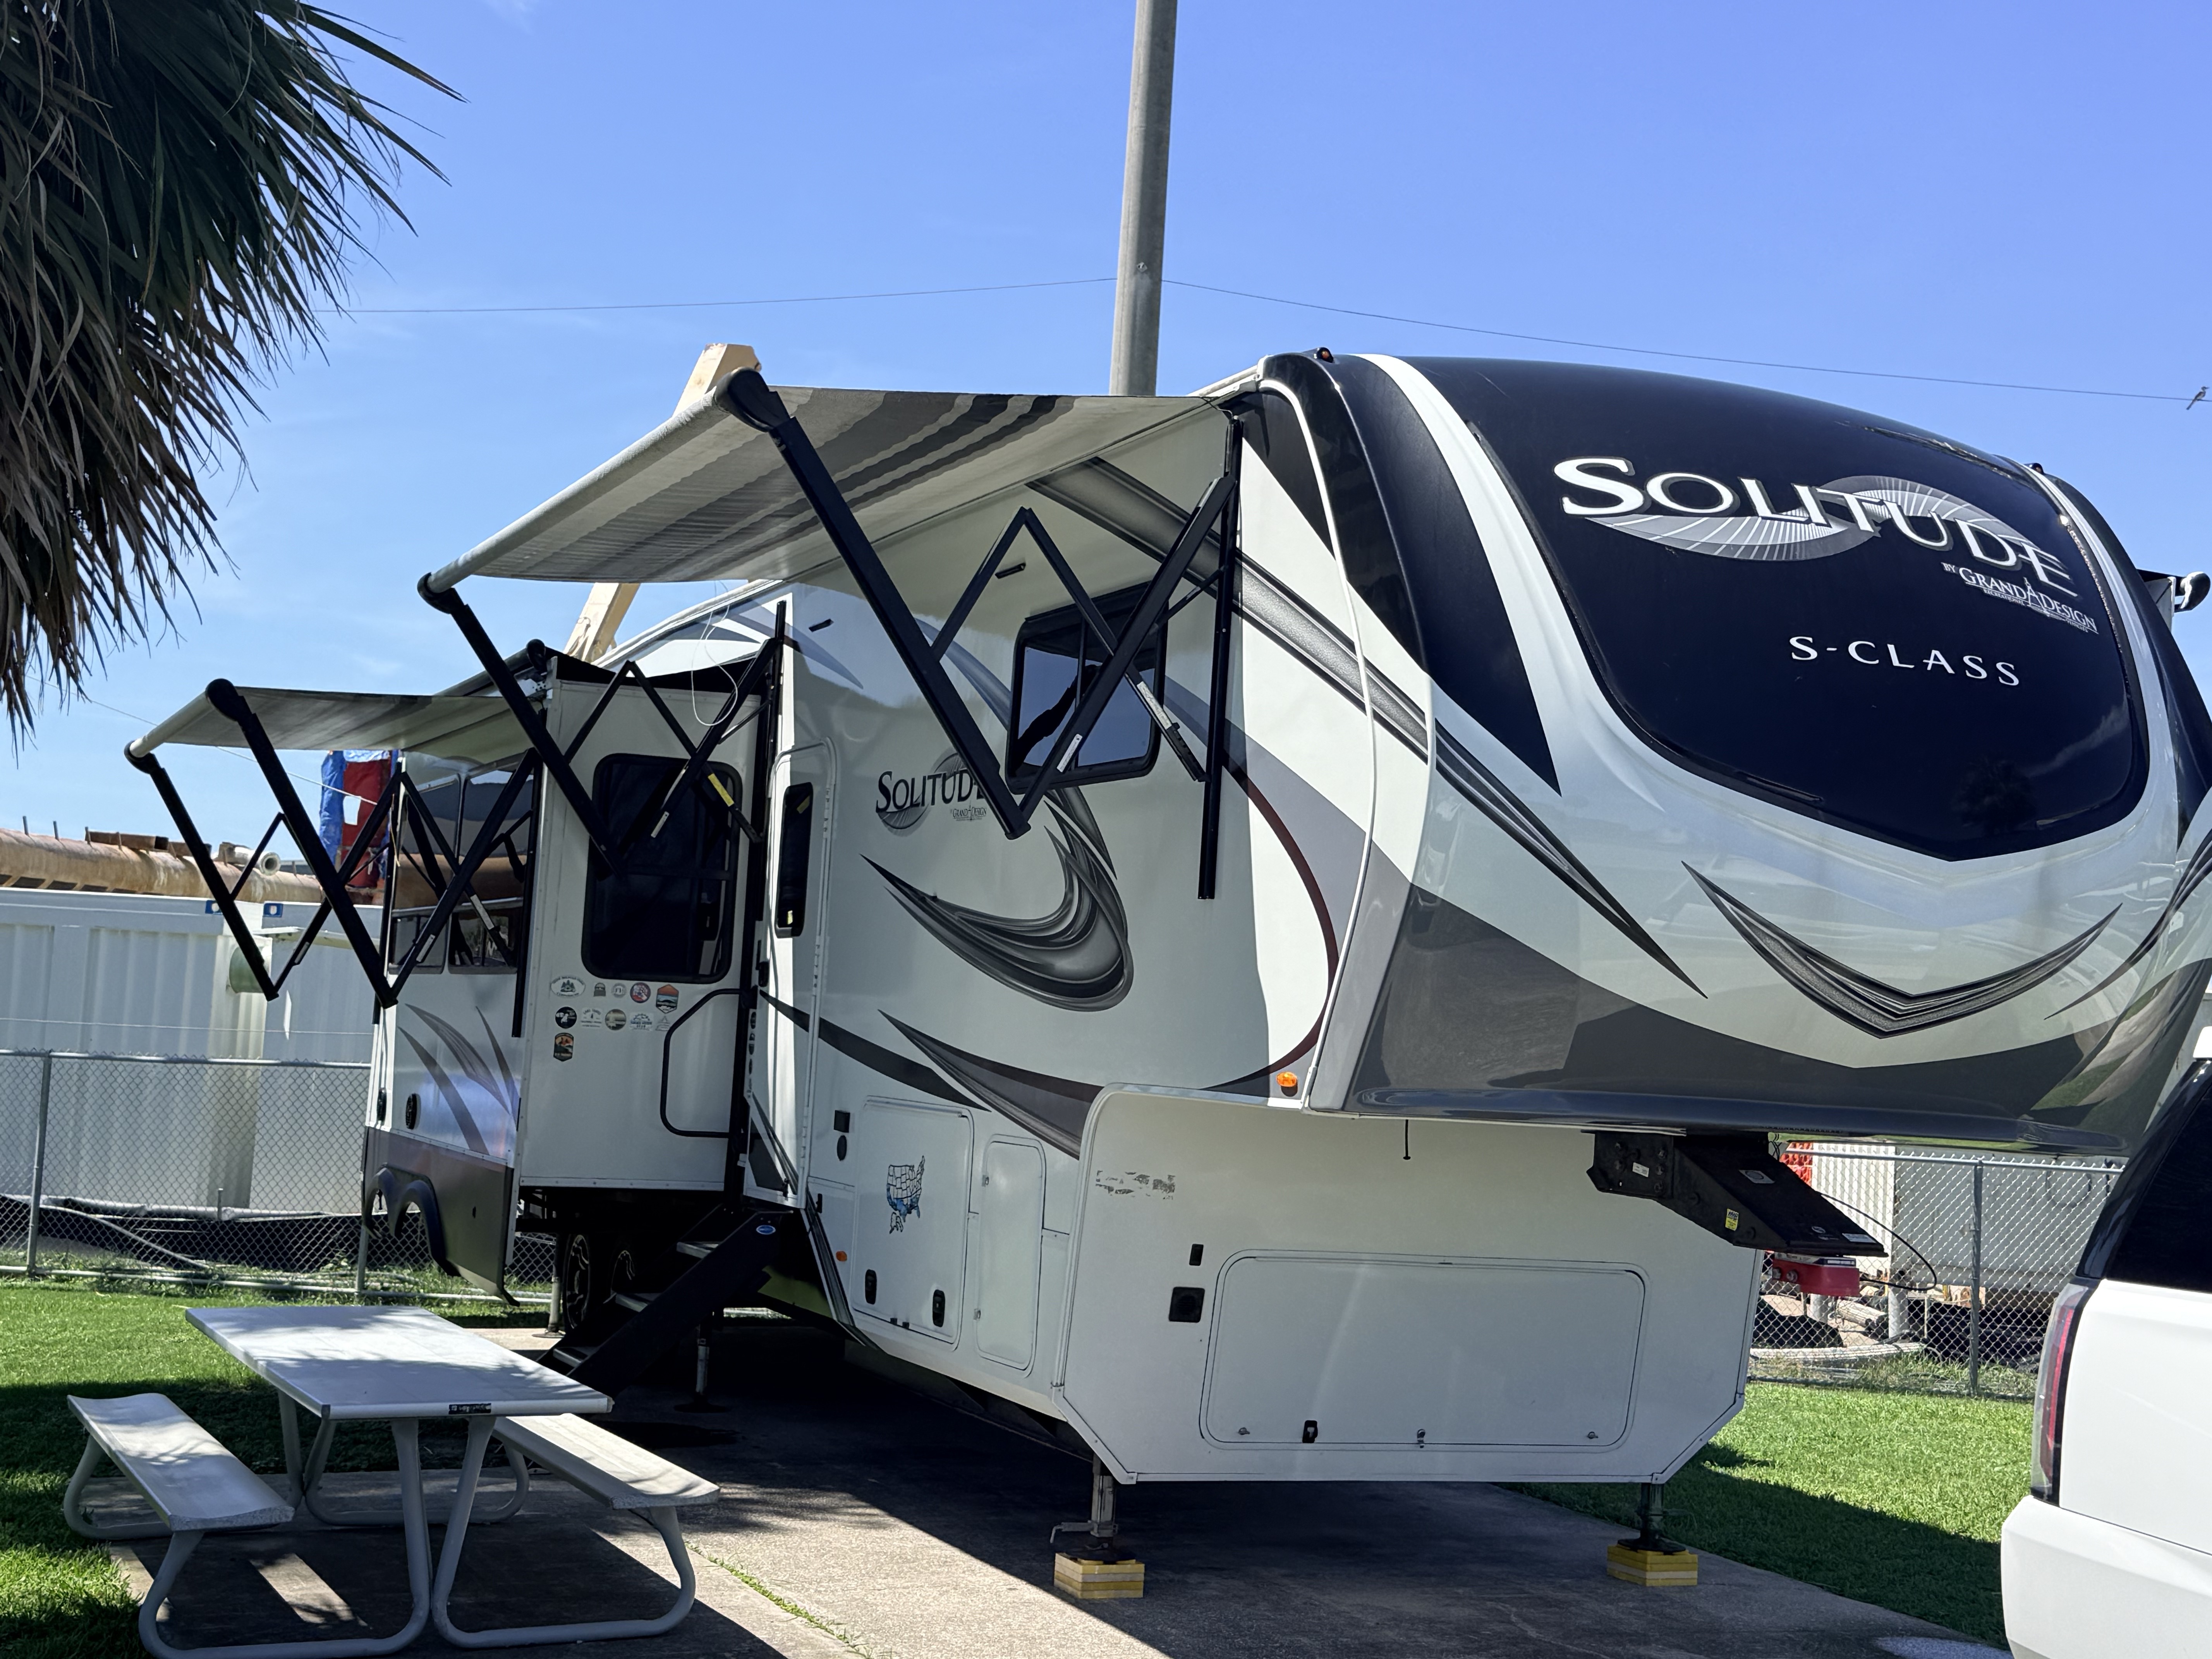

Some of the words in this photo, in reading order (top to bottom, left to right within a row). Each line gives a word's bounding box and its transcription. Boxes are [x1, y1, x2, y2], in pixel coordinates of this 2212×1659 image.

[1553, 456, 2078, 598] SOLITUDE
[1943, 563, 1956, 573] BY
[1959, 567, 2027, 599] GRAND
[2038, 592, 2098, 632] DESIGN
[1789, 636, 2020, 686] S-CLASS
